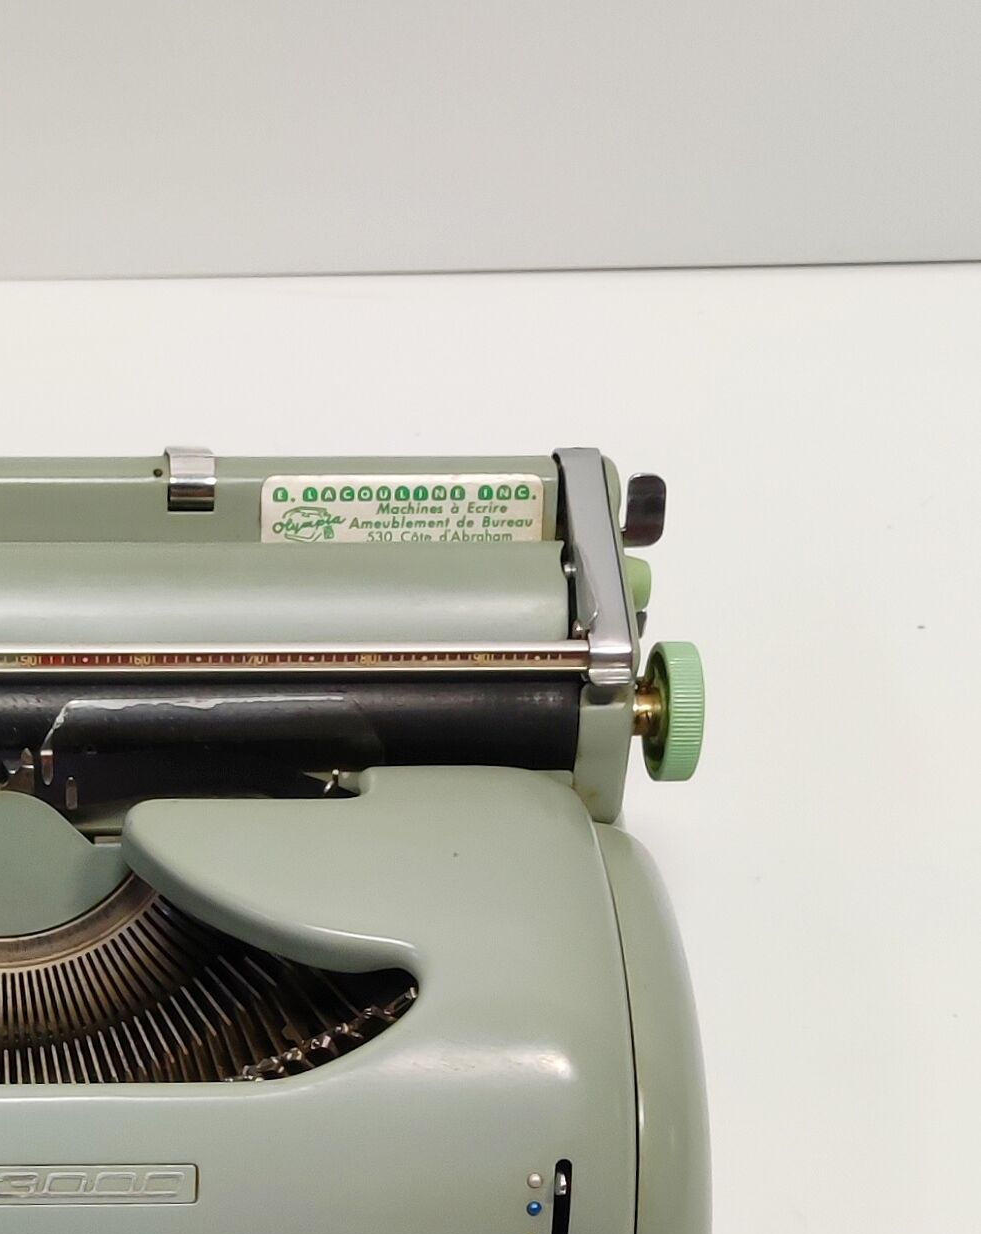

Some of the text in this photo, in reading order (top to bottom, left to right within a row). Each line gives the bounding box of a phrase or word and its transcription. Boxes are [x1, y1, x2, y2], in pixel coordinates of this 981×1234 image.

[478, 485, 537, 501] INC.
[377, 502, 508, 515] Machines à Ecrire
[349, 515, 534, 530] Ameublement de Bureau
[366, 531, 393, 542] 530
[400, 531, 433, 542] Côte
